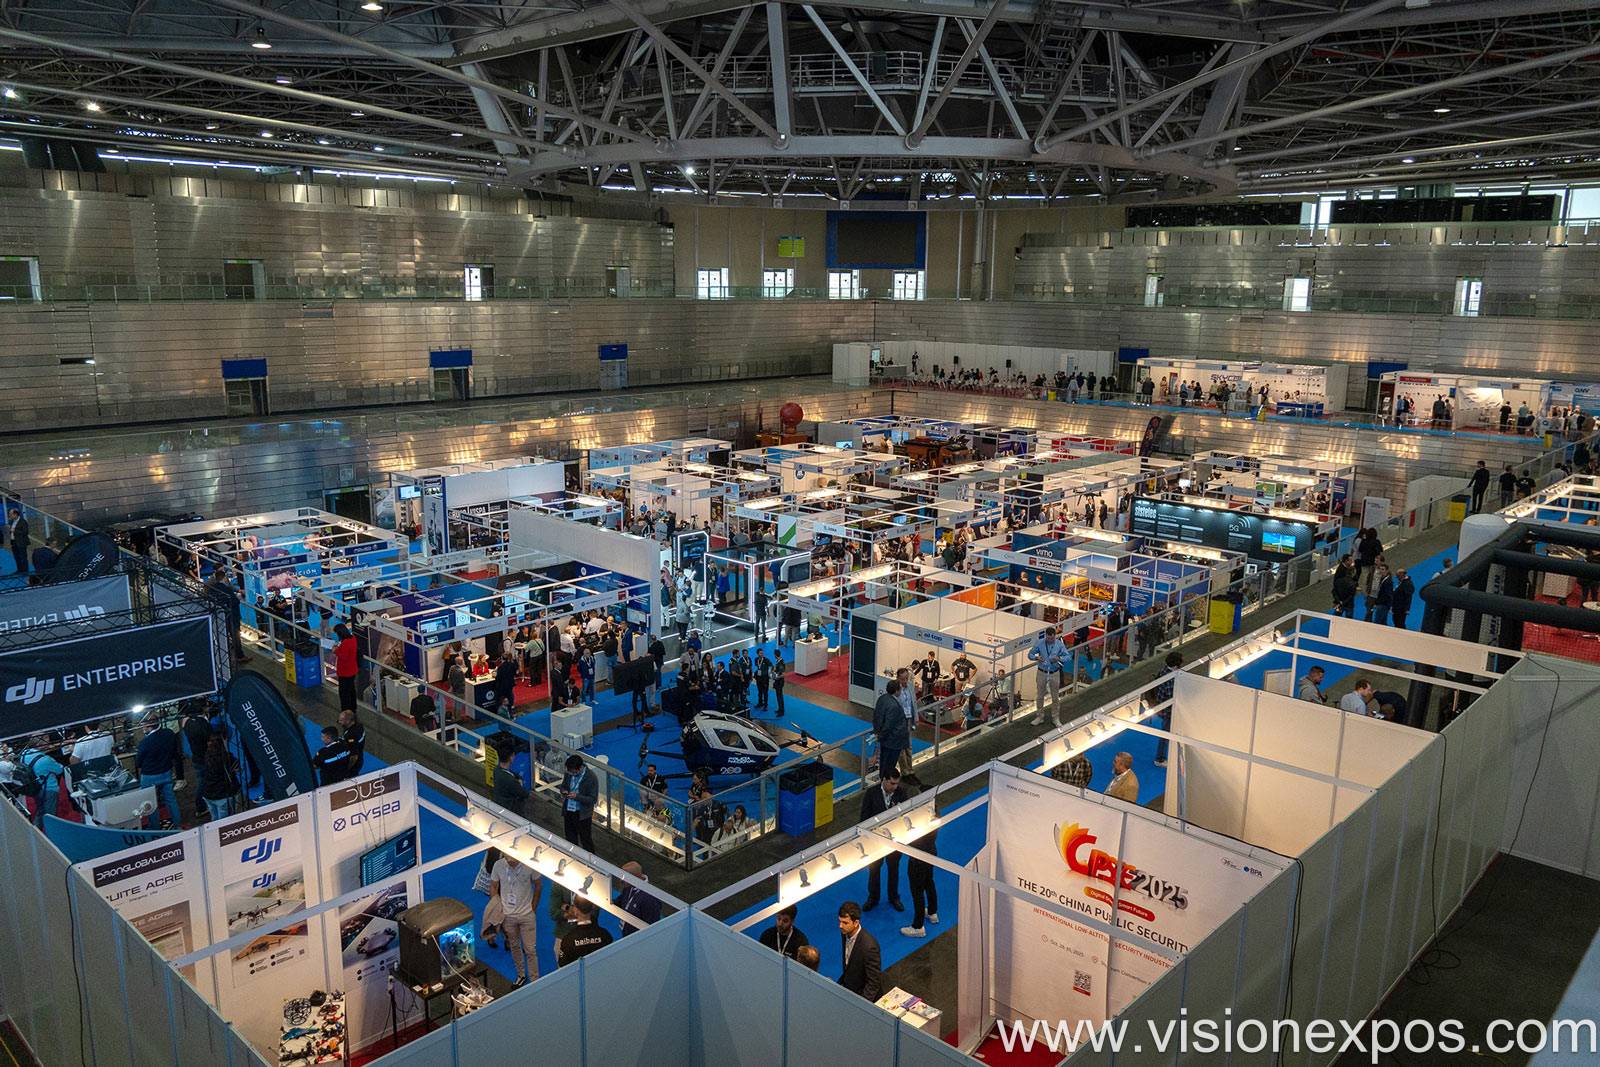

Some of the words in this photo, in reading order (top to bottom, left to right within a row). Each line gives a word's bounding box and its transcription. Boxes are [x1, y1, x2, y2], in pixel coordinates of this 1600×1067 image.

[63, 652, 186, 690] ENTERPRISE
[106, 885, 141, 902] UITE
[145, 871, 184, 890] ACRE
[1017, 877, 1038, 893] THE
[1058, 894, 1093, 916] CHINA
[1131, 869, 1188, 910] 2025
[1033, 906, 1074, 930] INTERNATIONAL
